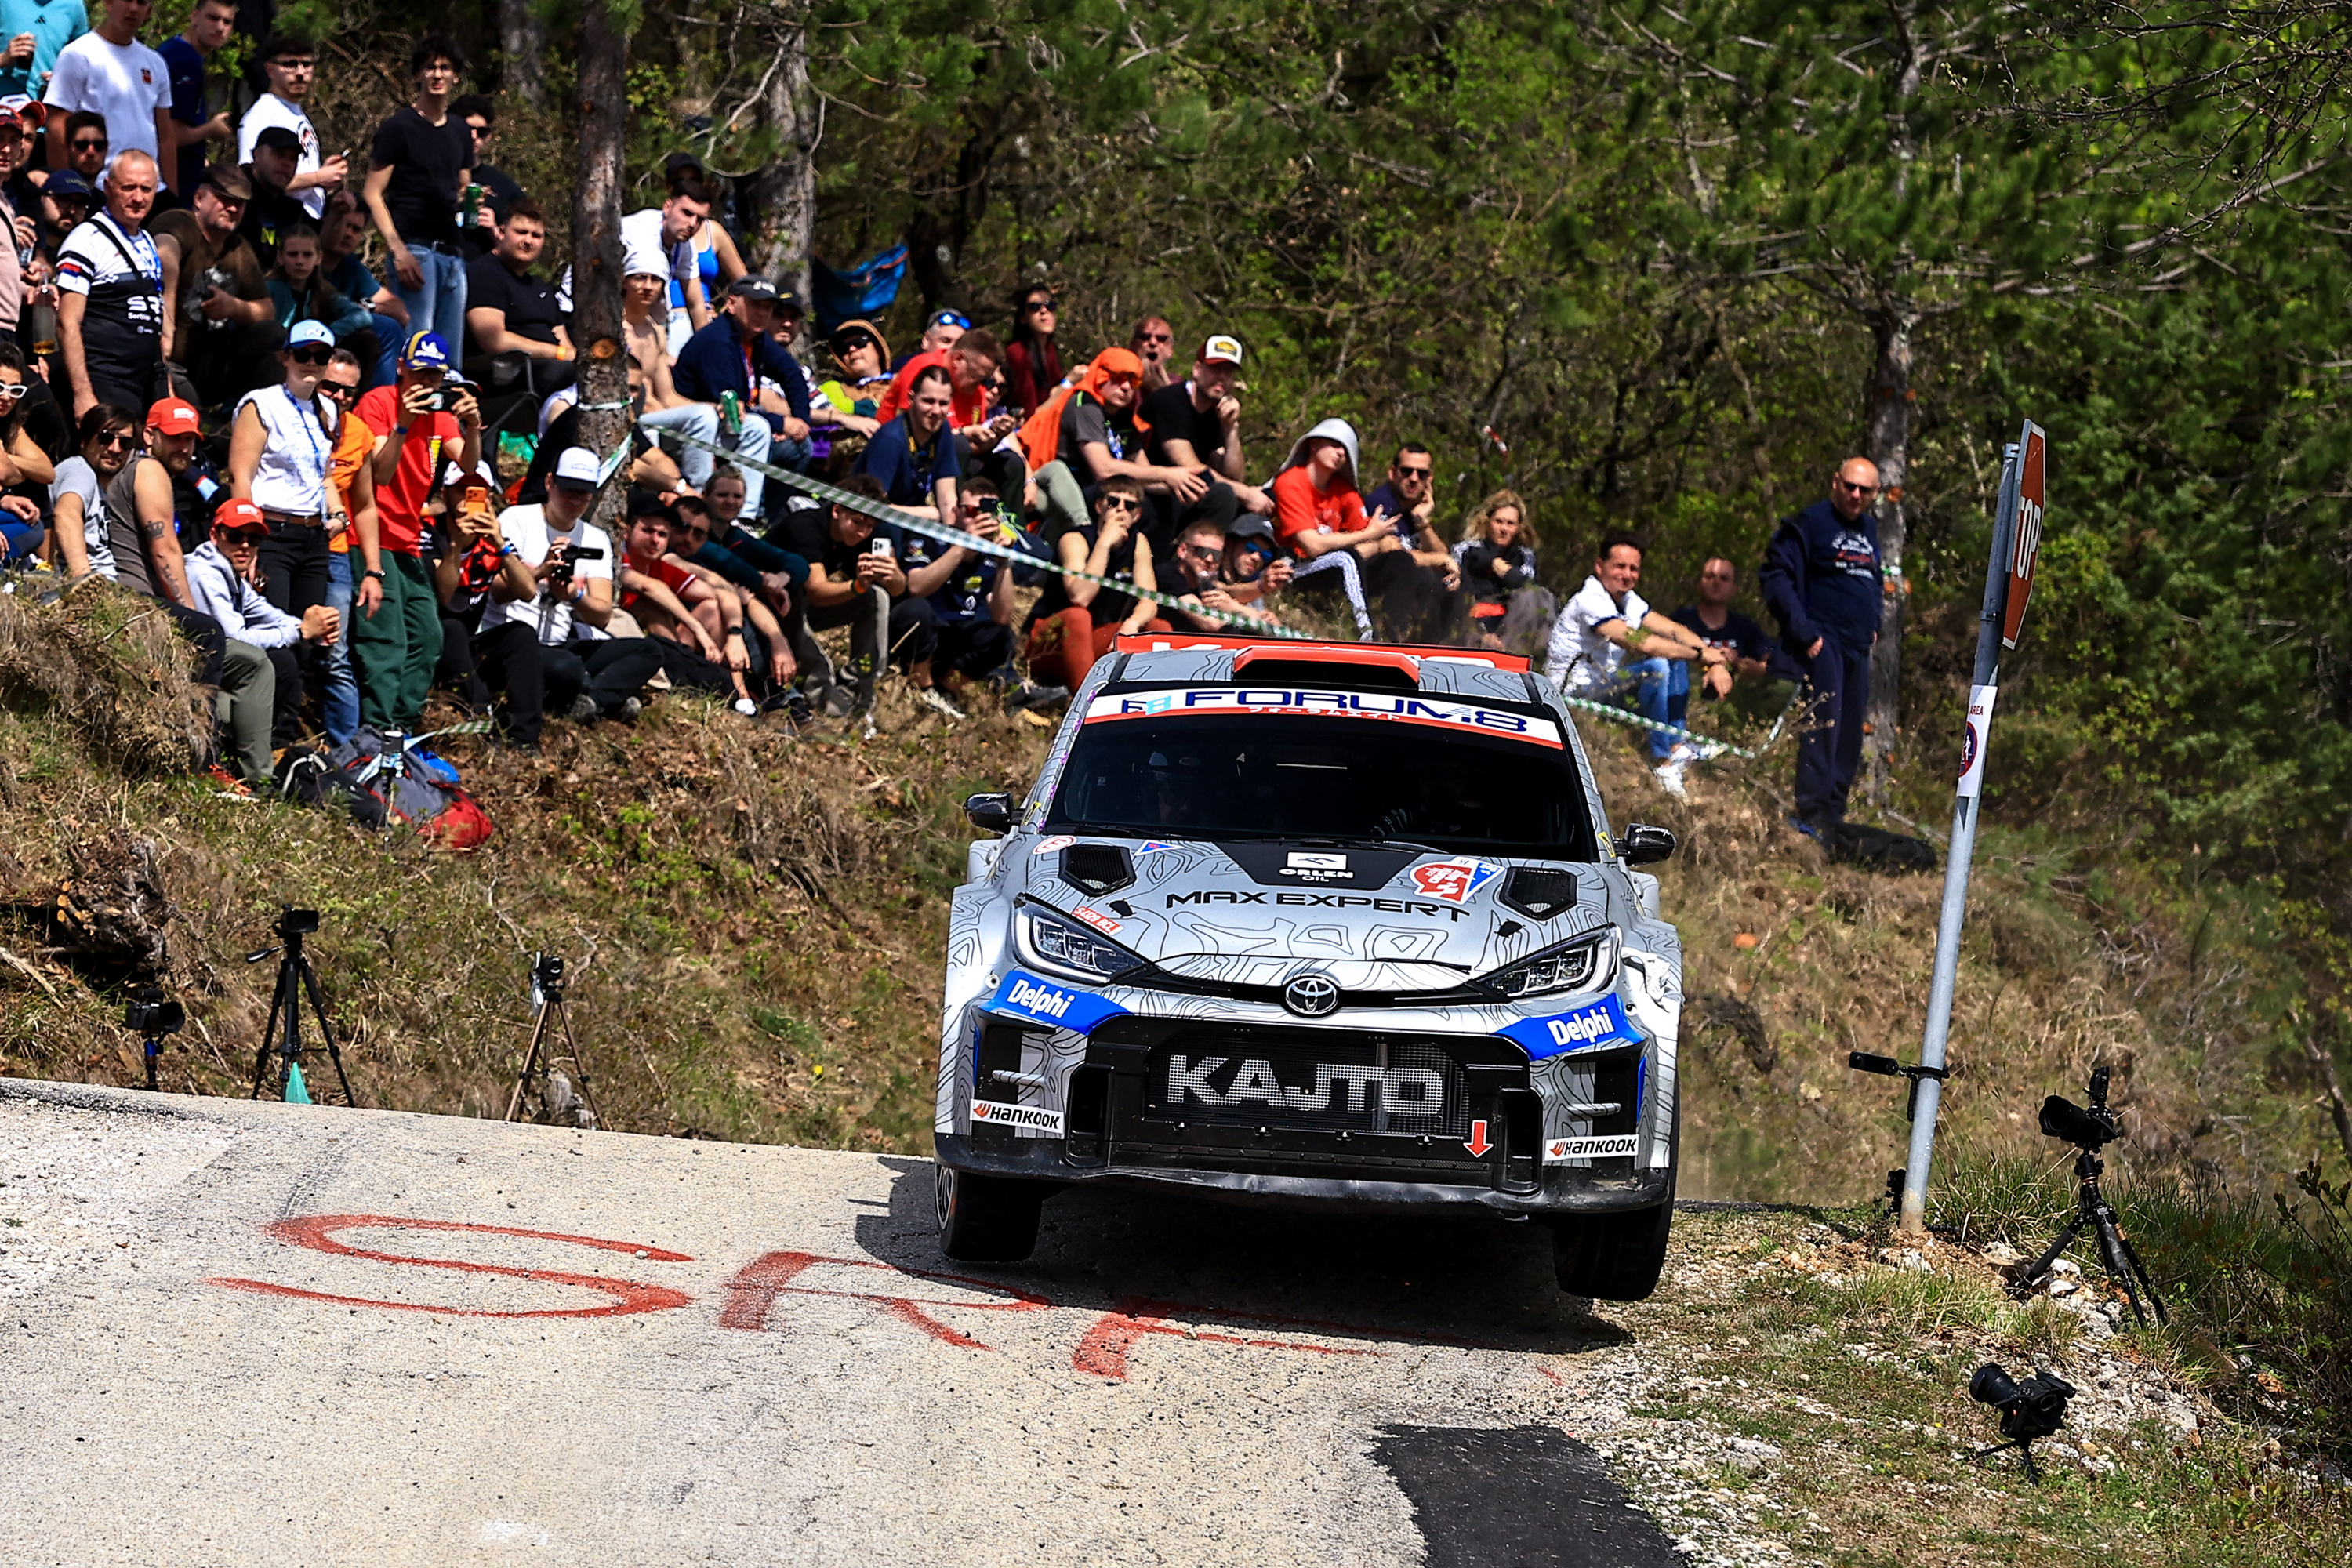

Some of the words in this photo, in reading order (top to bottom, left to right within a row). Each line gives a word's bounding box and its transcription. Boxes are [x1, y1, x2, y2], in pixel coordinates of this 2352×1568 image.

[1185, 691, 1527, 731] FORUM8
[1969, 705, 1984, 716] AREA
[1279, 869, 1353, 879] ORLEN
[1166, 891, 1268, 909] MAX
[1276, 892, 1470, 923] EXPERT
[1007, 979, 1076, 1018] Delphi
[1547, 1006, 1615, 1046] Delphi
[1167, 1054, 1443, 1116] KAJTO
